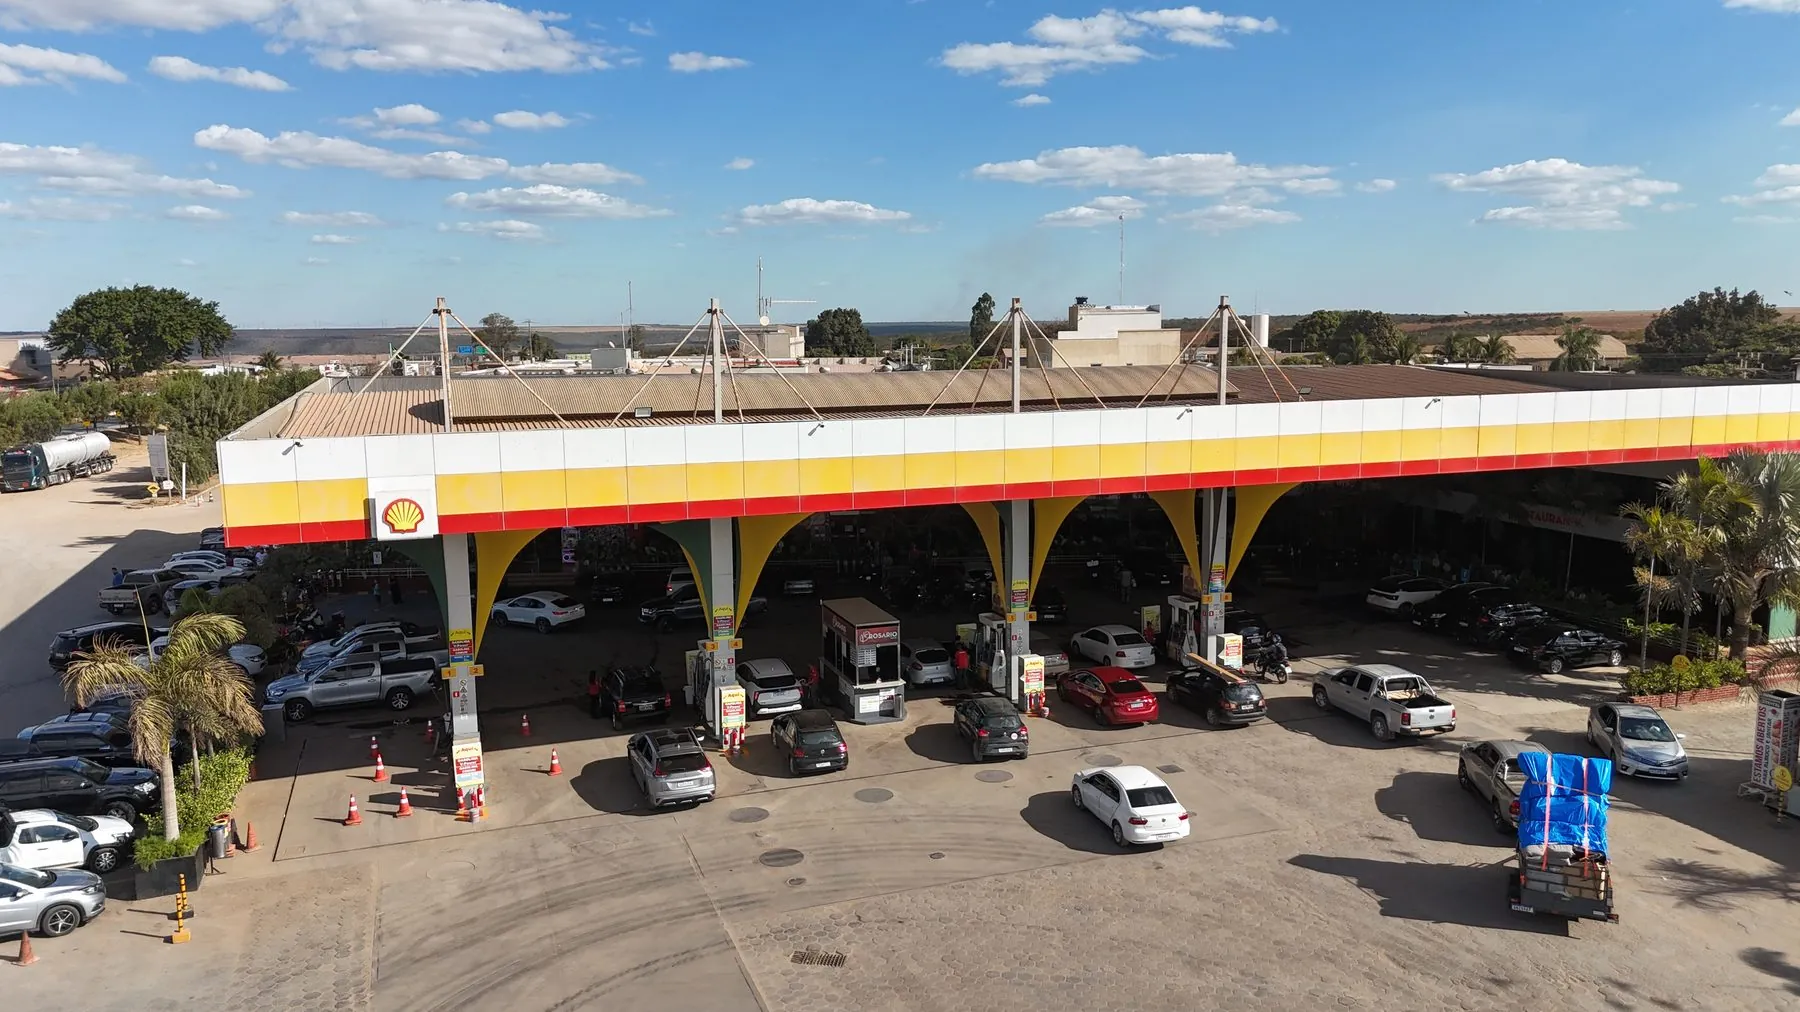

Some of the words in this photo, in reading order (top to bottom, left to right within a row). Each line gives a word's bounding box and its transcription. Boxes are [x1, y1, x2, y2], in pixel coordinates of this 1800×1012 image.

[868, 631, 898, 640] ROSARIO
[1757, 706, 1767, 744] ABERTOS
[1753, 744, 1765, 783] ESTAMOS
